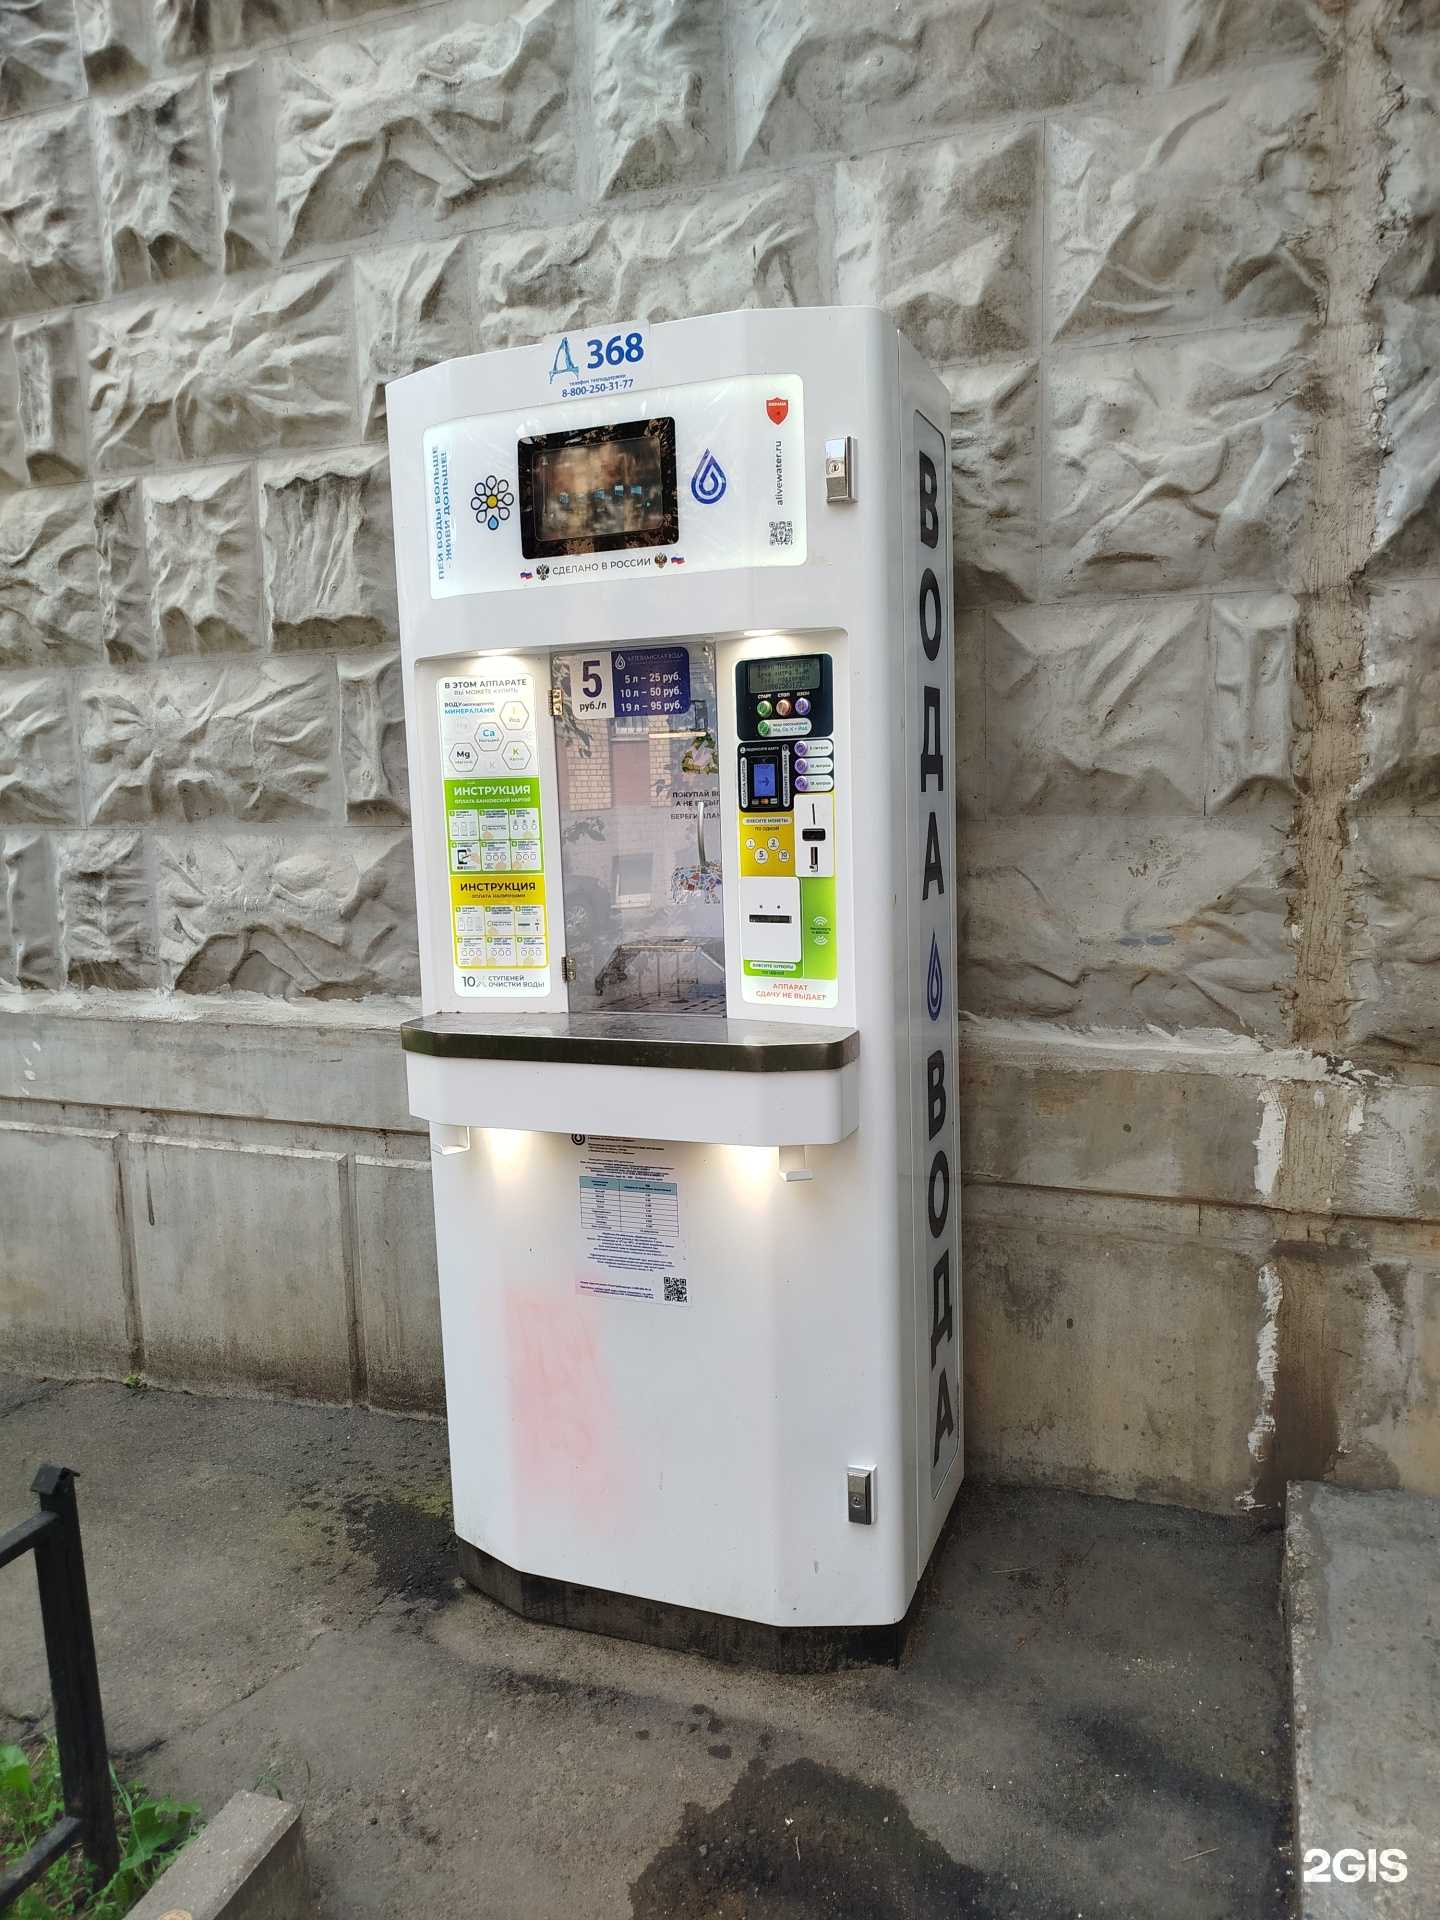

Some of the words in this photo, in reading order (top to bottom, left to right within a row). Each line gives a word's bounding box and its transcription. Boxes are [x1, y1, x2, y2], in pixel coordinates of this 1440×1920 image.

[587, 332, 644, 369] 368
[561, 379, 634, 398] 8-800-250-31-77
[432, 446, 442, 505] БОЛЬШЕ
[775, 440, 783, 506] alivewater.ru
[435, 508, 444, 549] ВОДЫ
[443, 519, 452, 561] ЖИВИ
[437, 553, 445, 580] ПЕЙ
[552, 563, 599, 575] СДЕЛАНО
[602, 561, 608, 570] В
[610, 558, 651, 569] РОССИИ
[582, 660, 602, 698] 5
[624, 674, 631, 683] 5
[649, 673, 661, 682] 25
[663, 671, 682, 683] руб.
[919, 450, 944, 901] ВОДА
[452, 681, 477, 689] ЭТОМ
[479, 678, 527, 688] АППАРАТЕ
[621, 689, 631, 698] 10
[650, 687, 661, 697] 50
[663, 686, 682, 698] руб.
[444, 707, 496, 715] МИНЕРАЛАМИ
[580, 702, 607, 712] руб./л
[621, 703, 632, 712] 19
[650, 701, 662, 711] 95
[664, 700, 683, 712] руб.
[482, 729, 496, 737] Ca
[456, 750, 471, 759] Mg
[454, 785, 531, 796] ИНСТРУКЦИЯ
[672, 790, 710, 798] ПОКУПАЙ
[759, 850, 764, 858] 5
[460, 882, 536, 892] ИНСТРУКЦИЯ
[462, 976, 476, 987] 10
[773, 983, 808, 991] АППАРАТ
[755, 990, 781, 998] СДАЧУ
[794, 993, 826, 1001] ВЫДАЕТ
[927, 1049, 953, 1468] ВОДА
